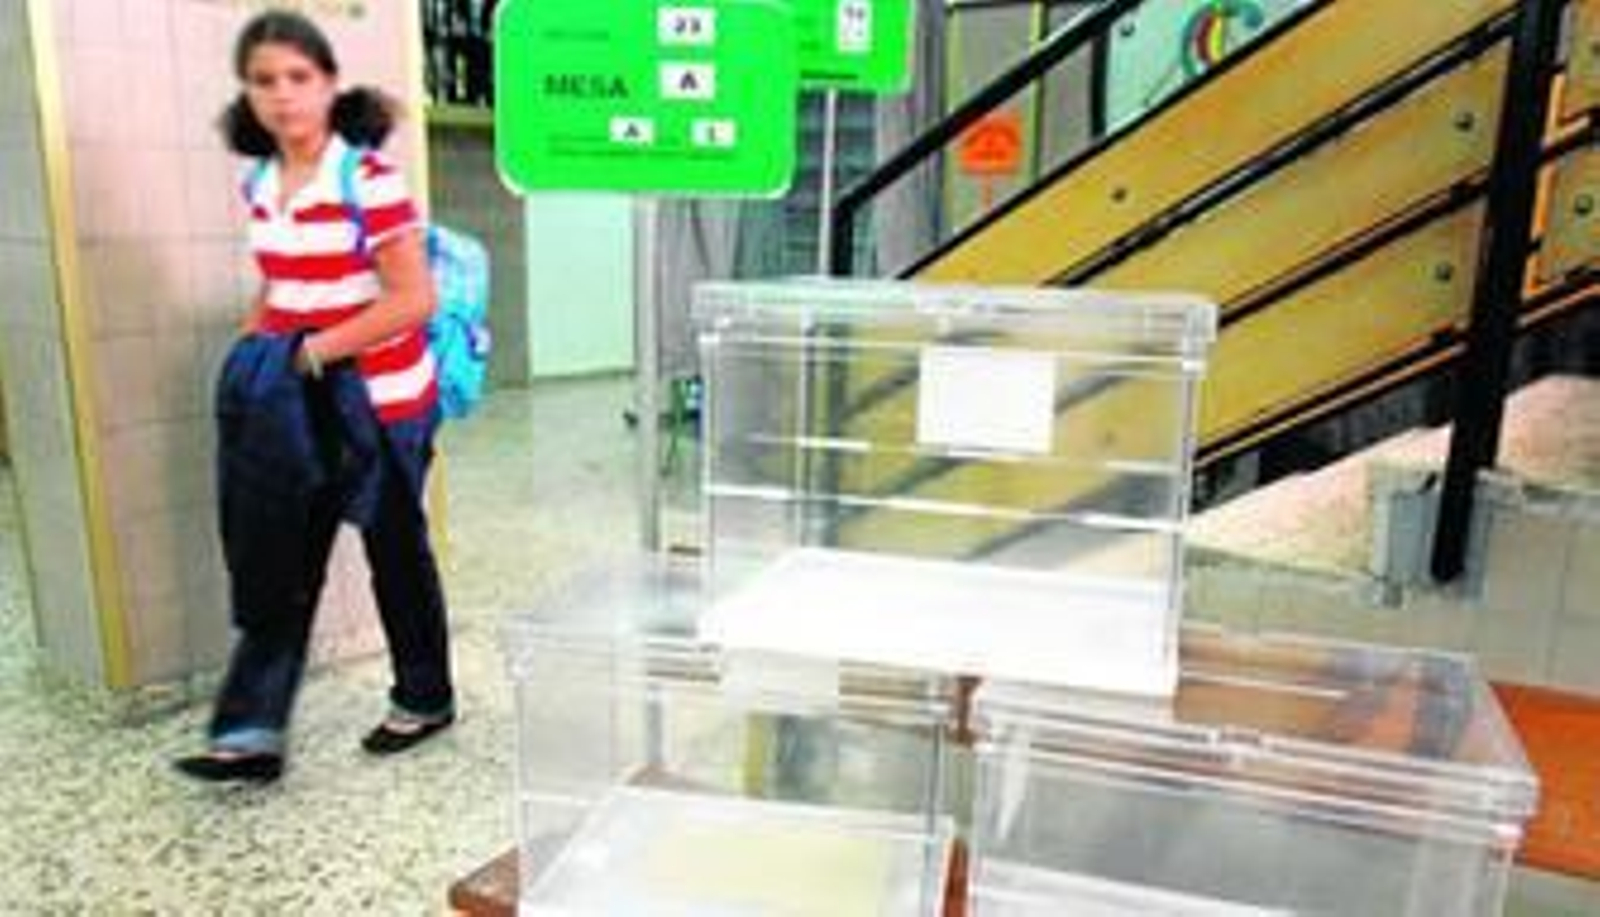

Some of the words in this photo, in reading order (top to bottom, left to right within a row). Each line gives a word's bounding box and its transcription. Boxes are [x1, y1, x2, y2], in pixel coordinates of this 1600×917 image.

[544, 74, 629, 98] MESA
[678, 69, 699, 91] A
[623, 122, 641, 138] A
